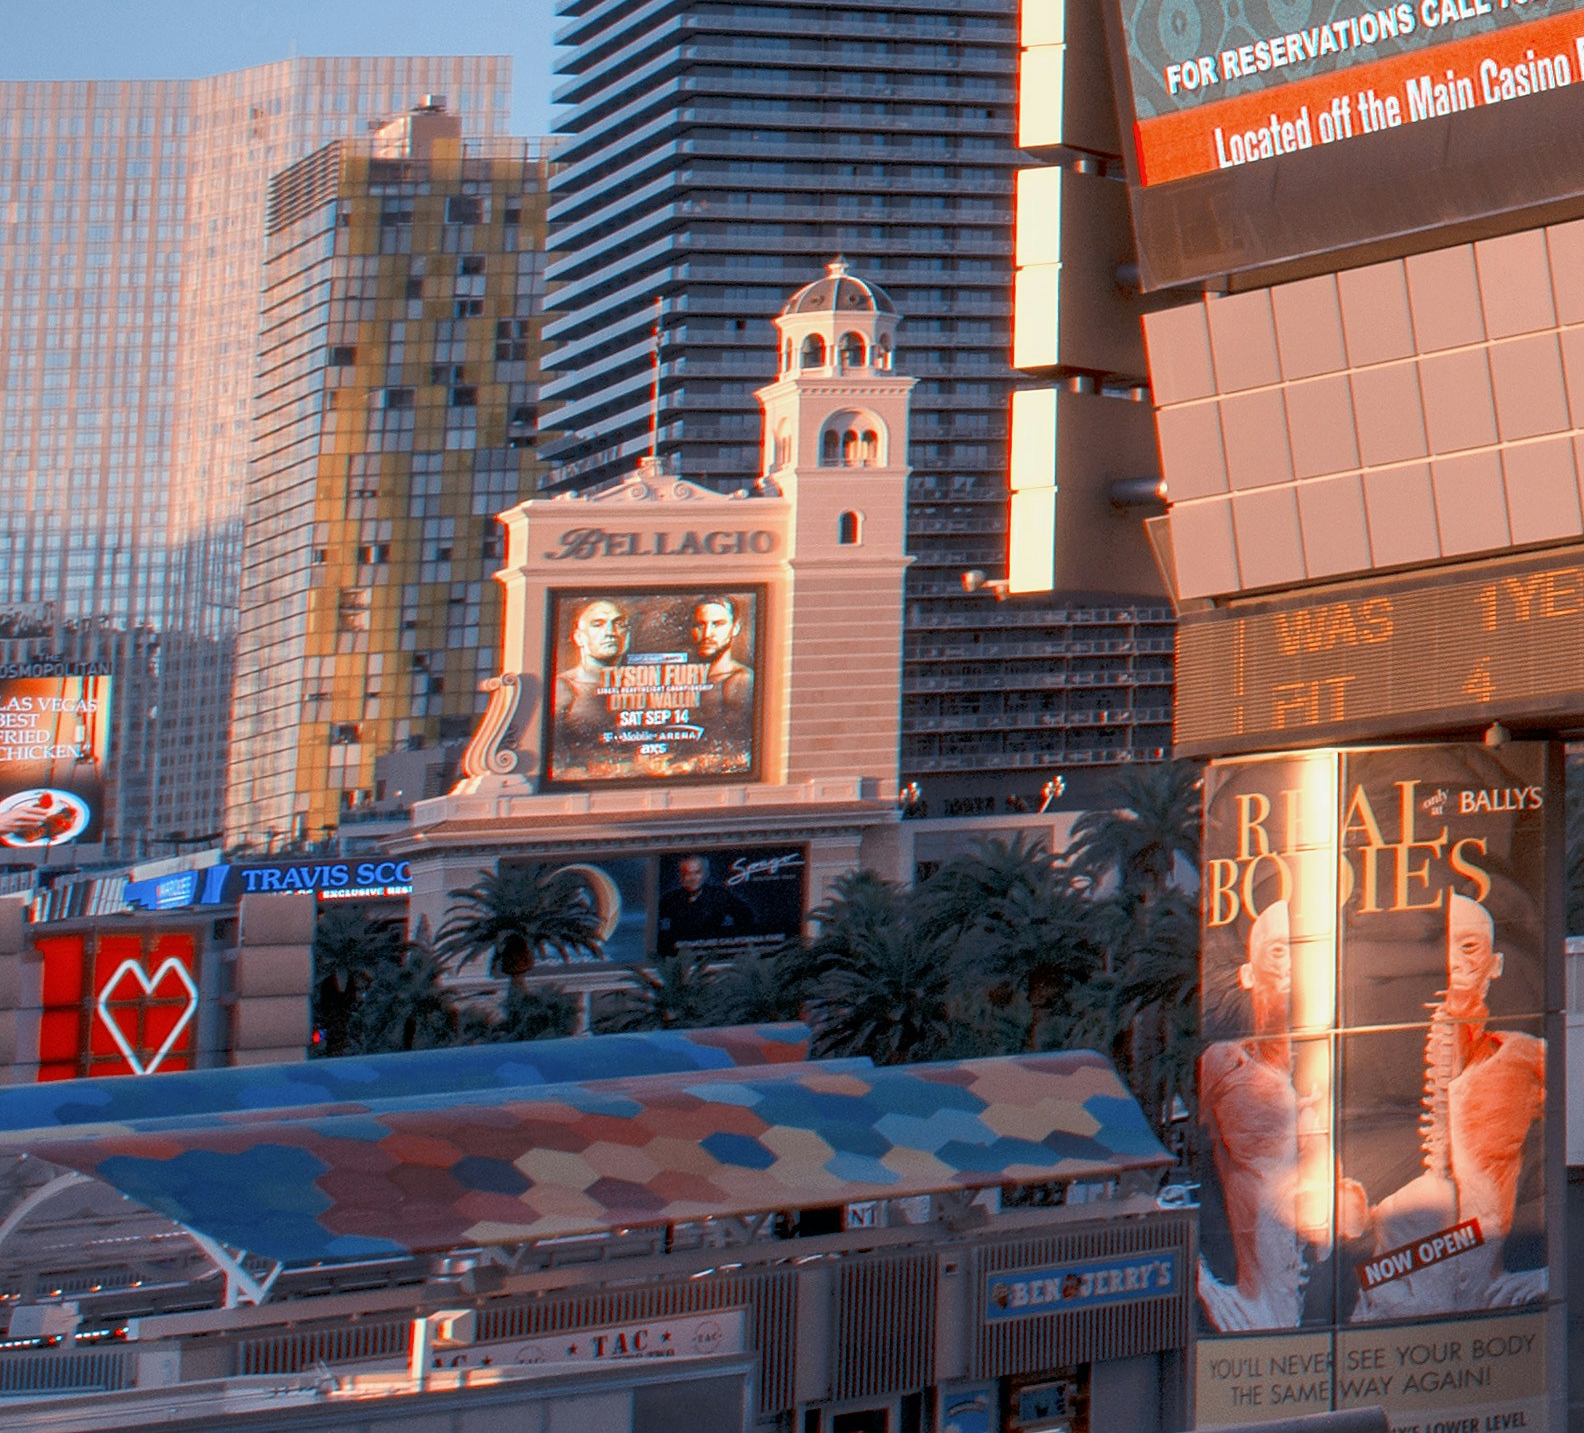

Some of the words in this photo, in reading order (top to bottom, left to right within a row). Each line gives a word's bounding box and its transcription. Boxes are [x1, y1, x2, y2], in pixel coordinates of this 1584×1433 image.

[1165, 56, 1219, 96] FOR
[1221, 3, 1415, 81] RESERVATIONS
[1213, 107, 1311, 169] Located
[1319, 98, 1353, 145] off
[1357, 90, 1402, 137] the
[1406, 70, 1475, 123] Main
[1479, 50, 1571, 105] Casino
[544, 527, 777, 560] BELLAGIO
[1274, 597, 1394, 657] WAS
[601, 665, 661, 687] TYSON
[662, 664, 711, 686] FURY
[1462, 656, 1495, 702] 4
[38, 697, 98, 712] VEGAS
[616, 710, 642, 726] SAT
[643, 709, 671, 726] SEP
[673, 709, 689, 724] 14
[1423, 788, 1448, 811] only
[1459, 786, 1543, 814] BALLY'S
[242, 865, 349, 892] TRAVIS
[1365, 1254, 1412, 1285] NOW
[1419, 1225, 1478, 1264] OPEN!
[1010, 1277, 1061, 1307] BEN
[1079, 1260, 1172, 1298] JERRY'S
[1210, 1358, 1262, 1380] YOU'LL
[1347, 1348, 1385, 1371] SEE
[1396, 1341, 1462, 1367] YOUR
[1472, 1334, 1536, 1359] BODY
[1231, 1384, 1261, 1407] THE
[1271, 1379, 1331, 1404] SAME
[1337, 1376, 1394, 1400] WAY
[1402, 1366, 1492, 1395] AGAIN!
[1485, 1411, 1526, 1432] LEVEL
